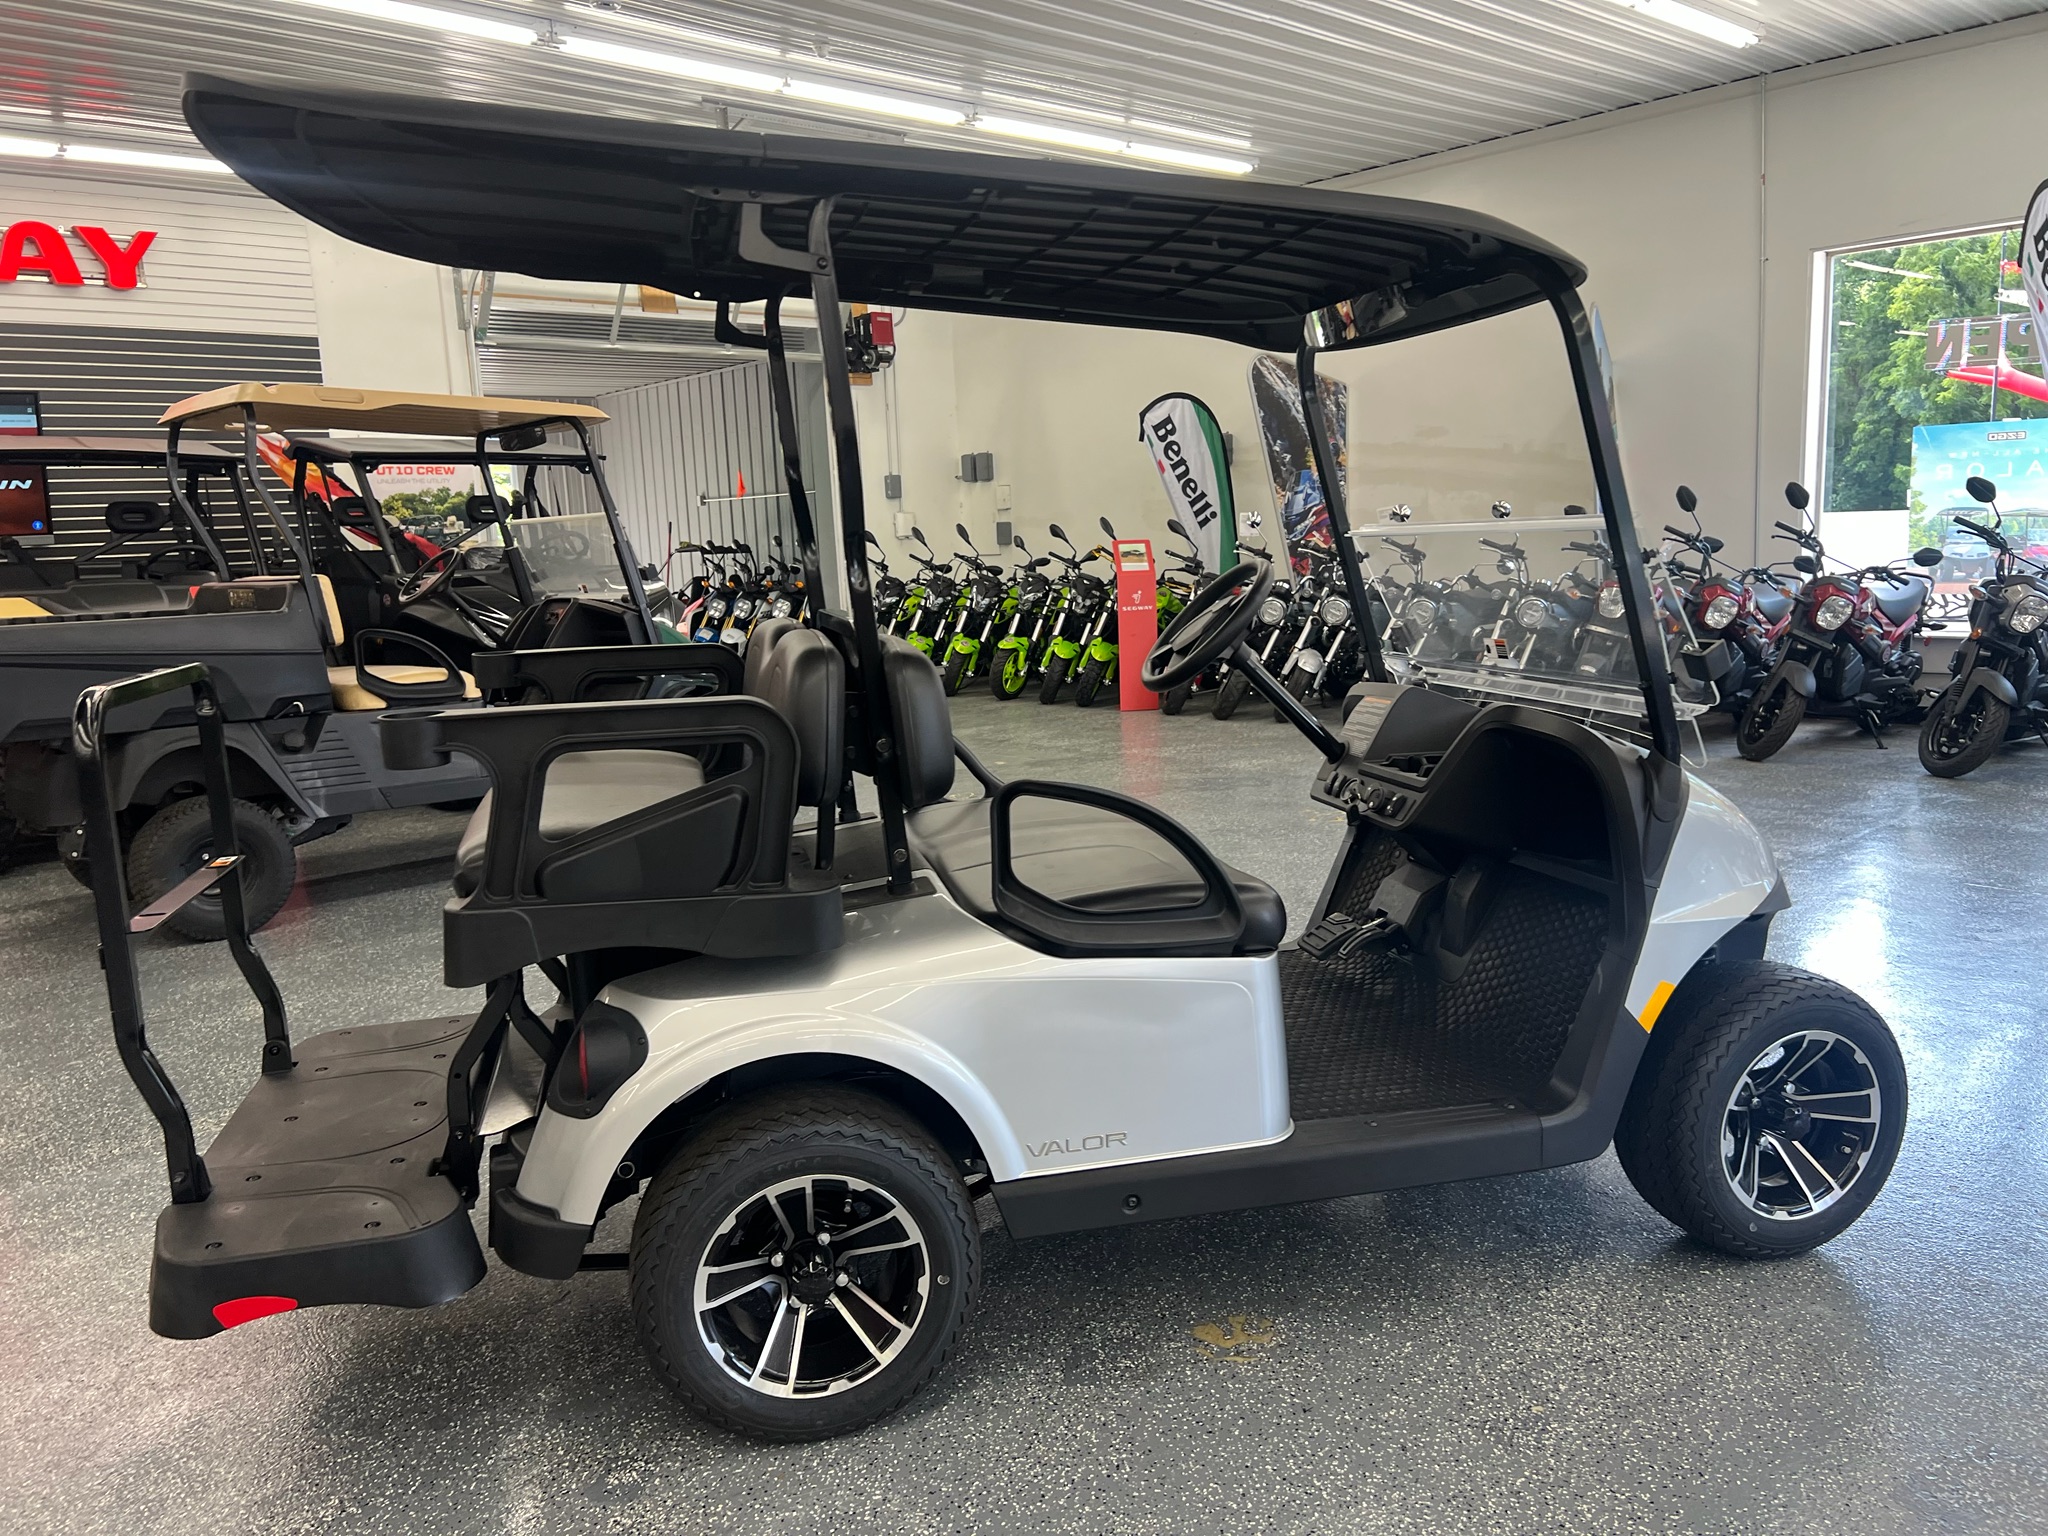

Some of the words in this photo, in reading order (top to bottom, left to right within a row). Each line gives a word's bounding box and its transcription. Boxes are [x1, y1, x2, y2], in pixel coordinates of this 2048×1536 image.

[0, 220, 159, 291] AY
[377, 466, 413, 475] UT10
[416, 466, 455, 475] CREW
[1151, 413, 1218, 531] Benelli
[1026, 1131, 1128, 1158] VALOR
